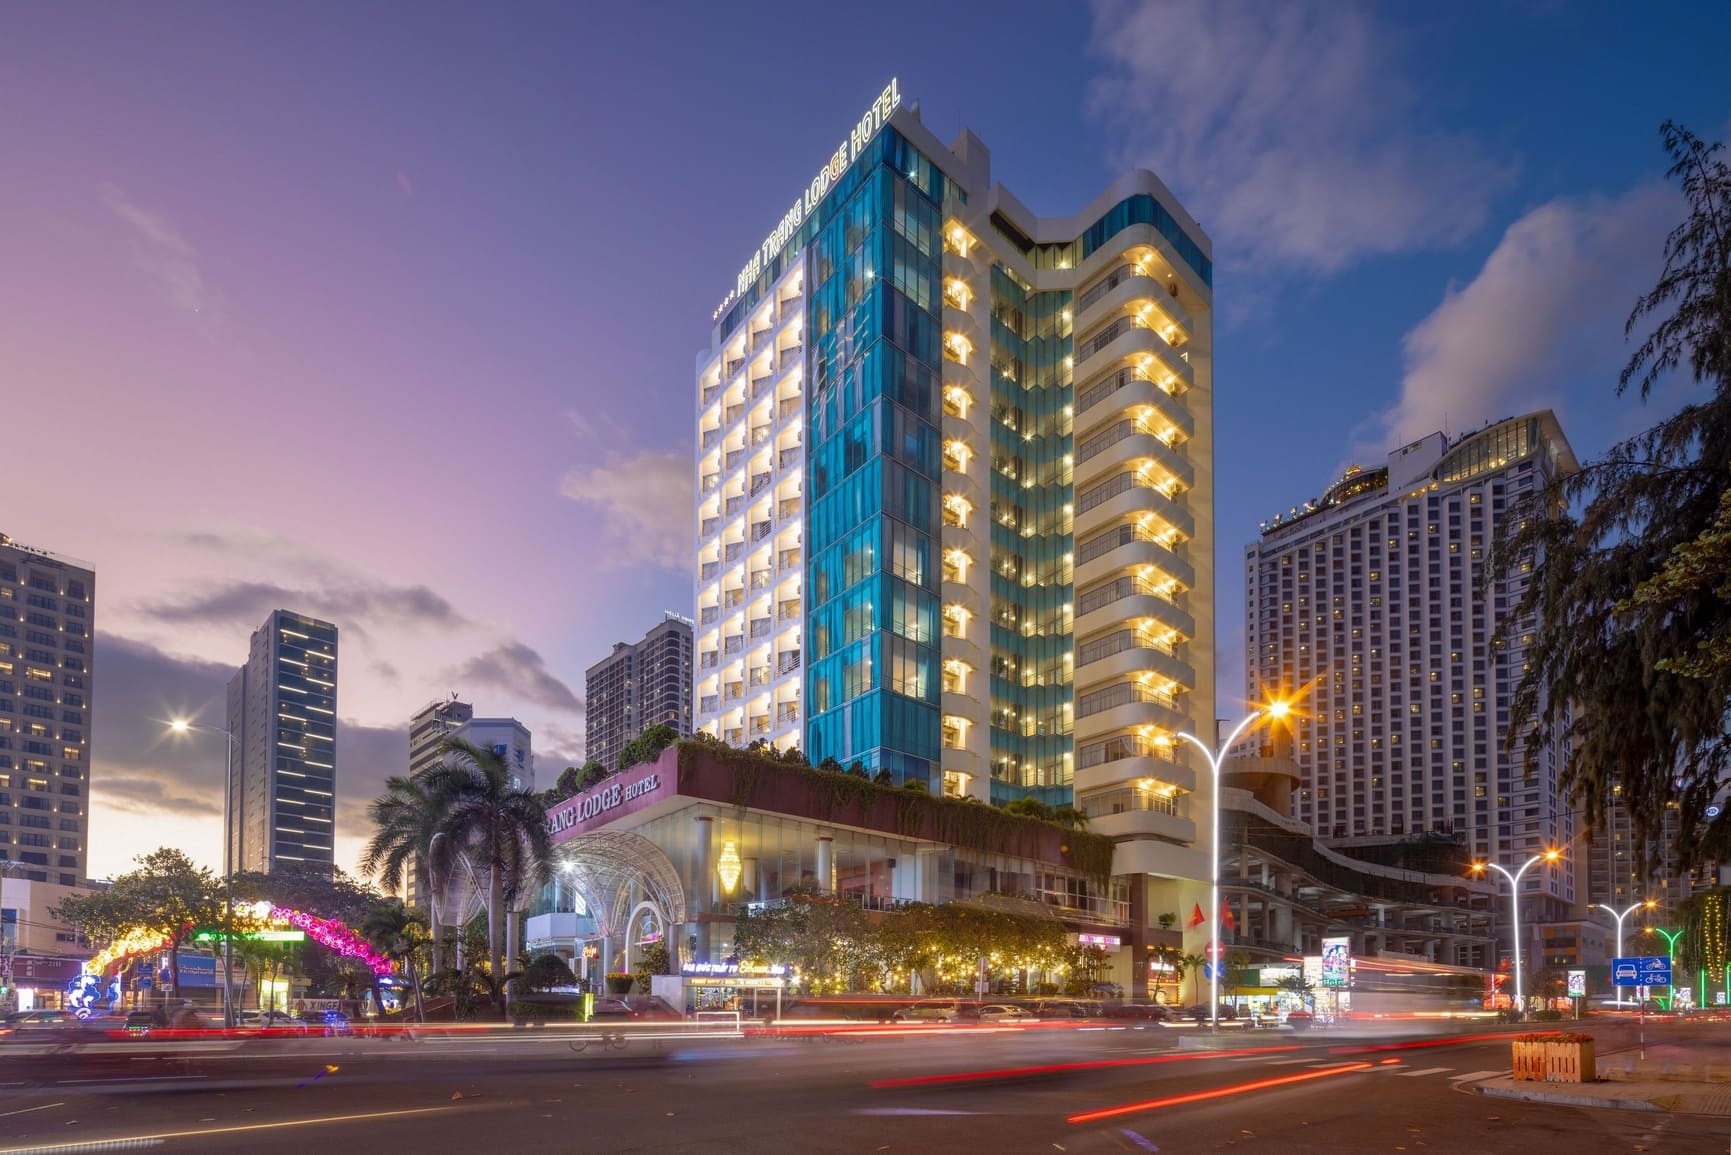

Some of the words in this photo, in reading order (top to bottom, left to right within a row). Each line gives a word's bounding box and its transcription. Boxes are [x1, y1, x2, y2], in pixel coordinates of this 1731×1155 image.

[737, 250, 761, 297] NHA
[762, 199, 802, 266] TRANG
[804, 141, 848, 216] LODGE
[851, 77, 900, 161] HOTEL
[546, 806, 576, 834] ANG
[577, 783, 622, 822] LODGE
[625, 774, 658, 801] HOTEL
